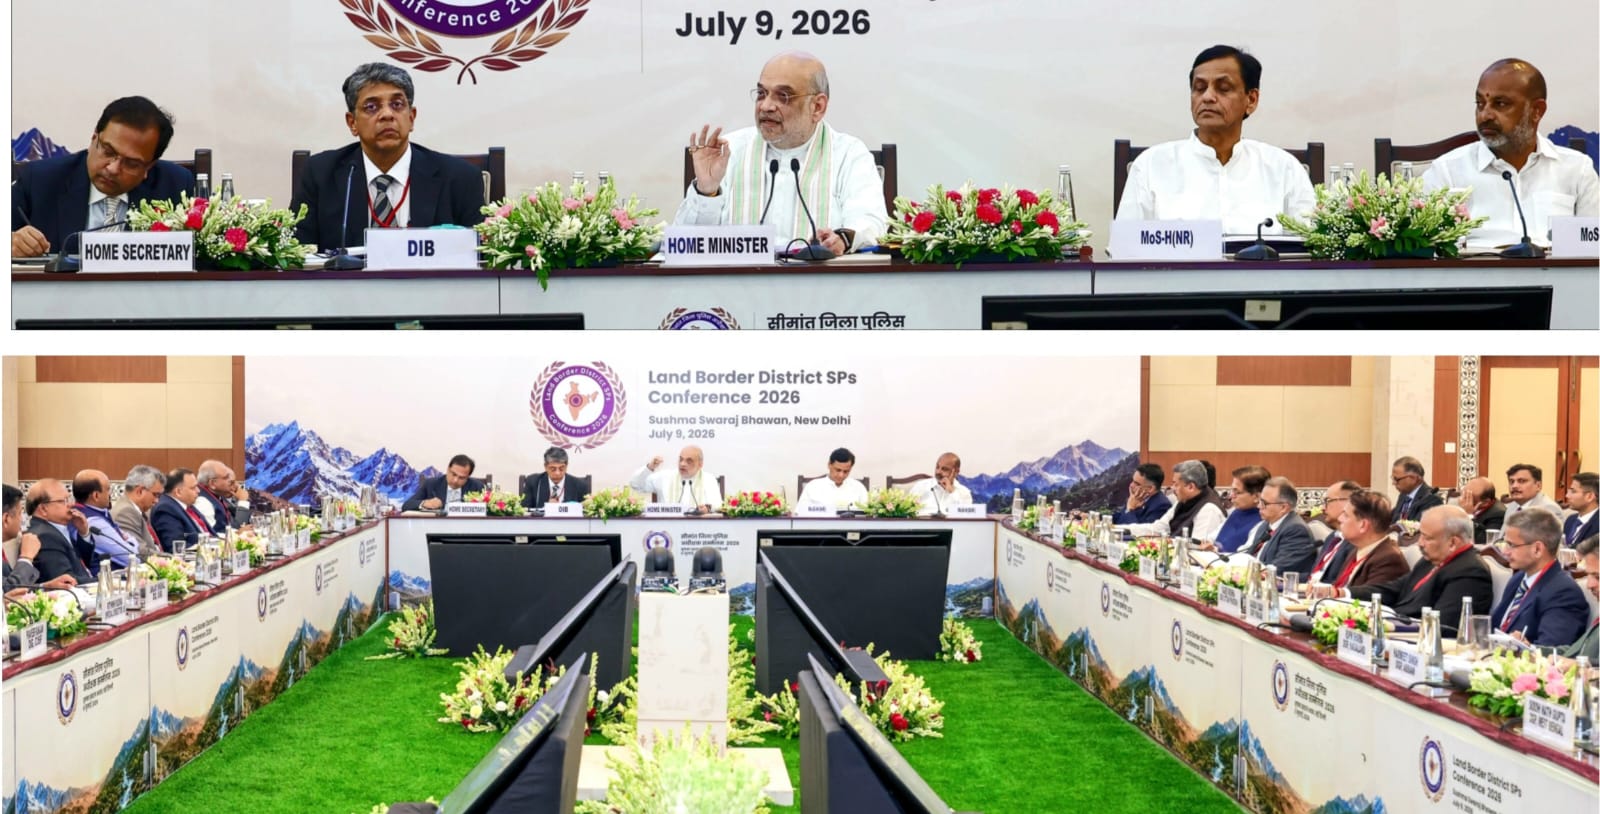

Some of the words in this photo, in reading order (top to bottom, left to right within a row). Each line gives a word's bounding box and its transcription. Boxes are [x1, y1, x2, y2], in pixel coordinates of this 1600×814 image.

[675, 11, 747, 45] July
[755, 10, 783, 40] 9,
[792, 9, 871, 35] 2026
[1141, 230, 1194, 248] MoS-H(NR)
[1581, 227, 1600, 241] MoS
[85, 243, 119, 261] HOME
[122, 243, 191, 261] SECRETARY
[408, 239, 435, 257] DIB
[668, 237, 705, 254] HOME
[708, 237, 769, 254] MINISTER
[767, 312, 816, 329] सीमांत
[819, 311, 858, 329] जिला
[648, 370, 691, 385] Land
[695, 369, 754, 385] Border
[758, 369, 823, 385] District
[826, 370, 857, 385] SPs
[648, 389, 751, 404] Conference
[758, 390, 801, 404] 2026
[648, 415, 697, 425] Sushma
[699, 415, 739, 427] Swaraj
[741, 415, 792, 426] Bhawan,
[794, 416, 819, 425] New
[822, 415, 851, 425] Delhi
[648, 429, 673, 441] July
[676, 430, 685, 440] 9,
[688, 429, 715, 439] 2026
